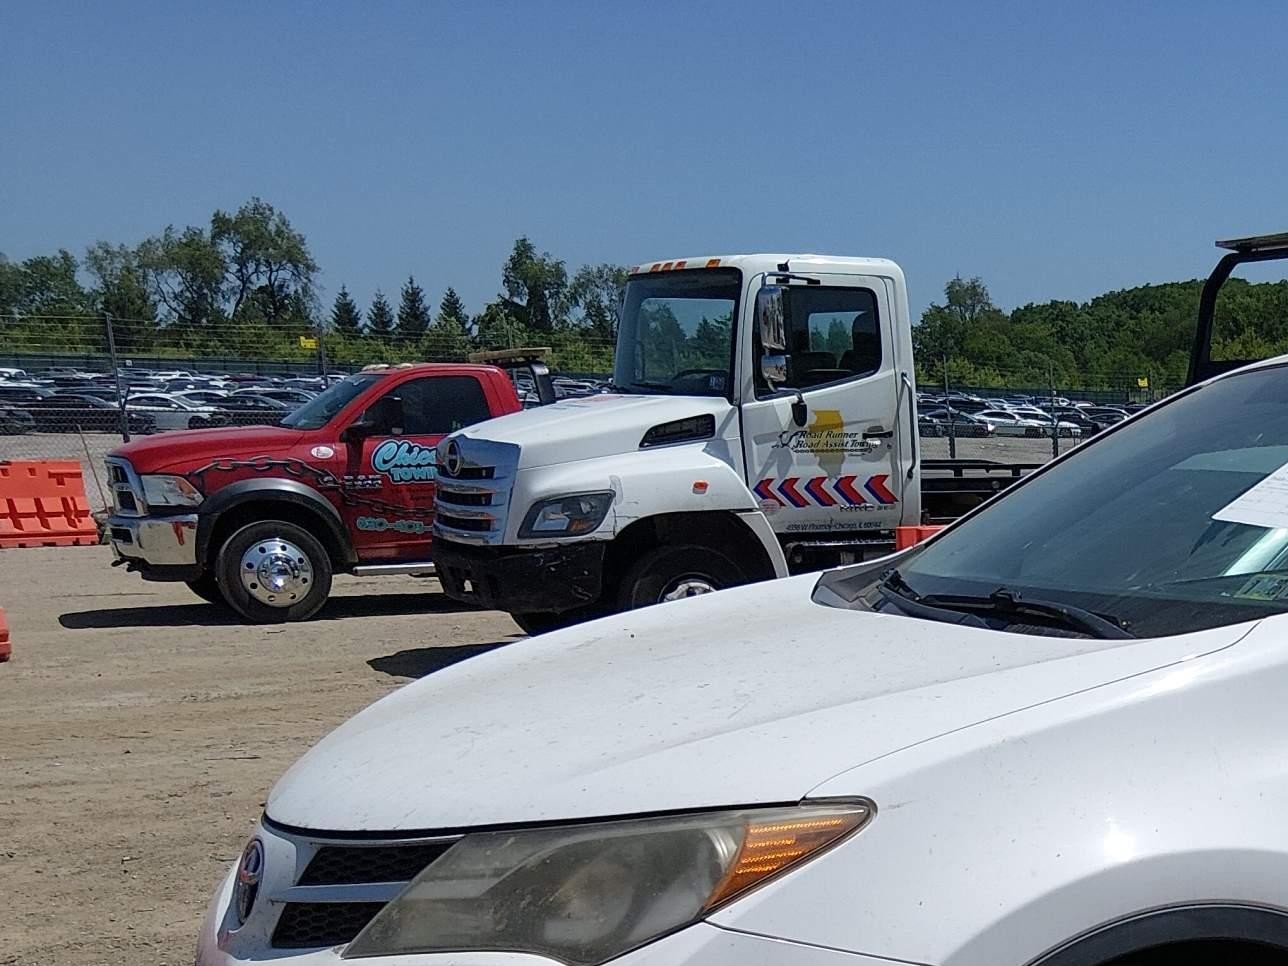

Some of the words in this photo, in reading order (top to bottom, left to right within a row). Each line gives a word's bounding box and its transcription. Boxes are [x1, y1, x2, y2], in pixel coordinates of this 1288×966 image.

[800, 430, 824, 439] Road
[825, 430, 859, 439] Runner
[822, 439, 847, 448] Assist
